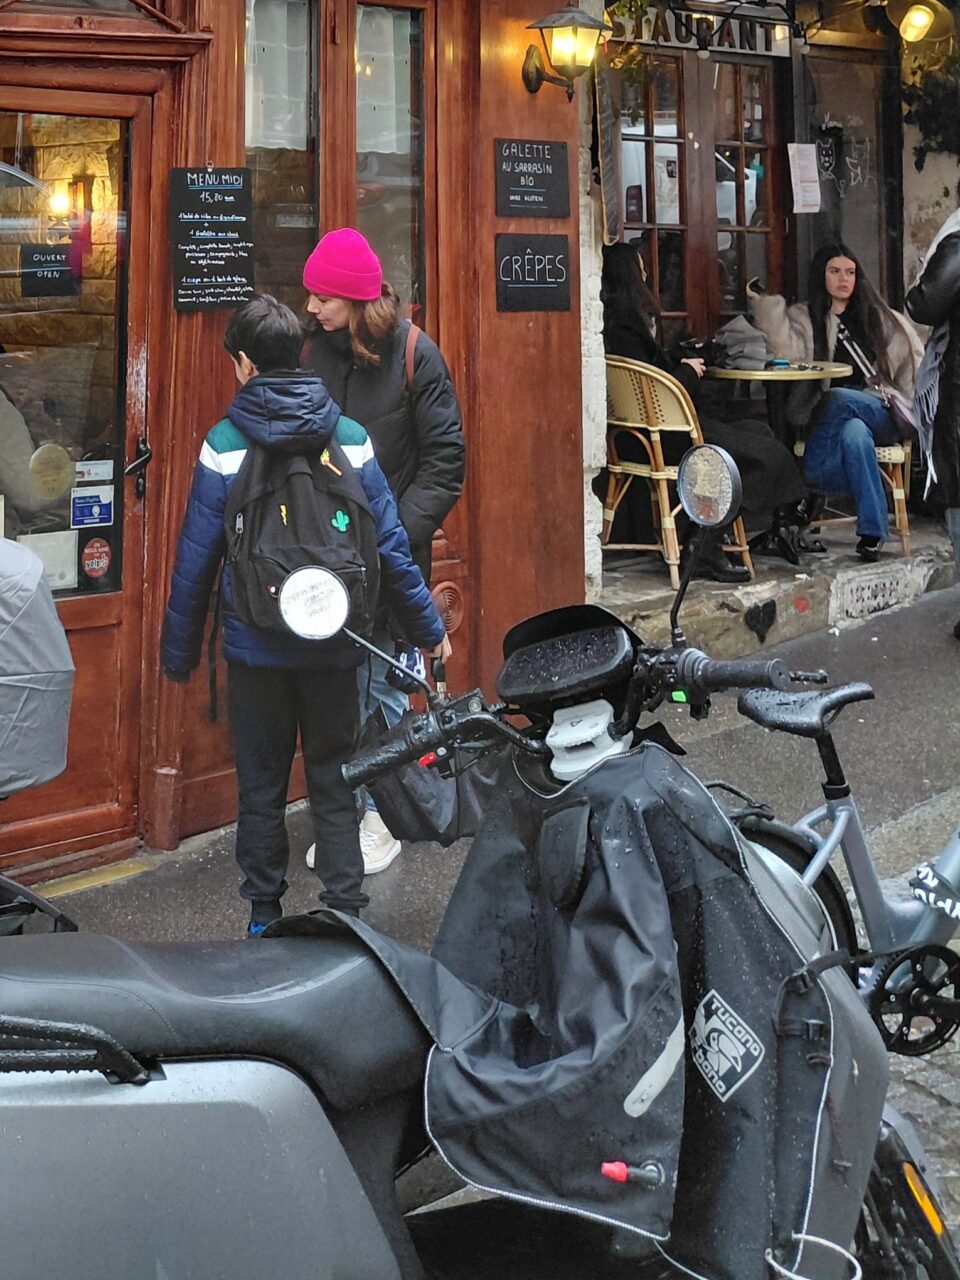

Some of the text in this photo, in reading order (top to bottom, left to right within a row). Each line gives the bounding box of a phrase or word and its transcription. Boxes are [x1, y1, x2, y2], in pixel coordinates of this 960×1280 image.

[502, 142, 551, 159] GALETTE
[502, 161, 553, 174] AU SARRASIN
[187, 172, 219, 186] MENU
[32, 253, 67, 261] OUVERT
[499, 248, 567, 282] CRÊPES
[36, 270, 61, 279] OPEN
